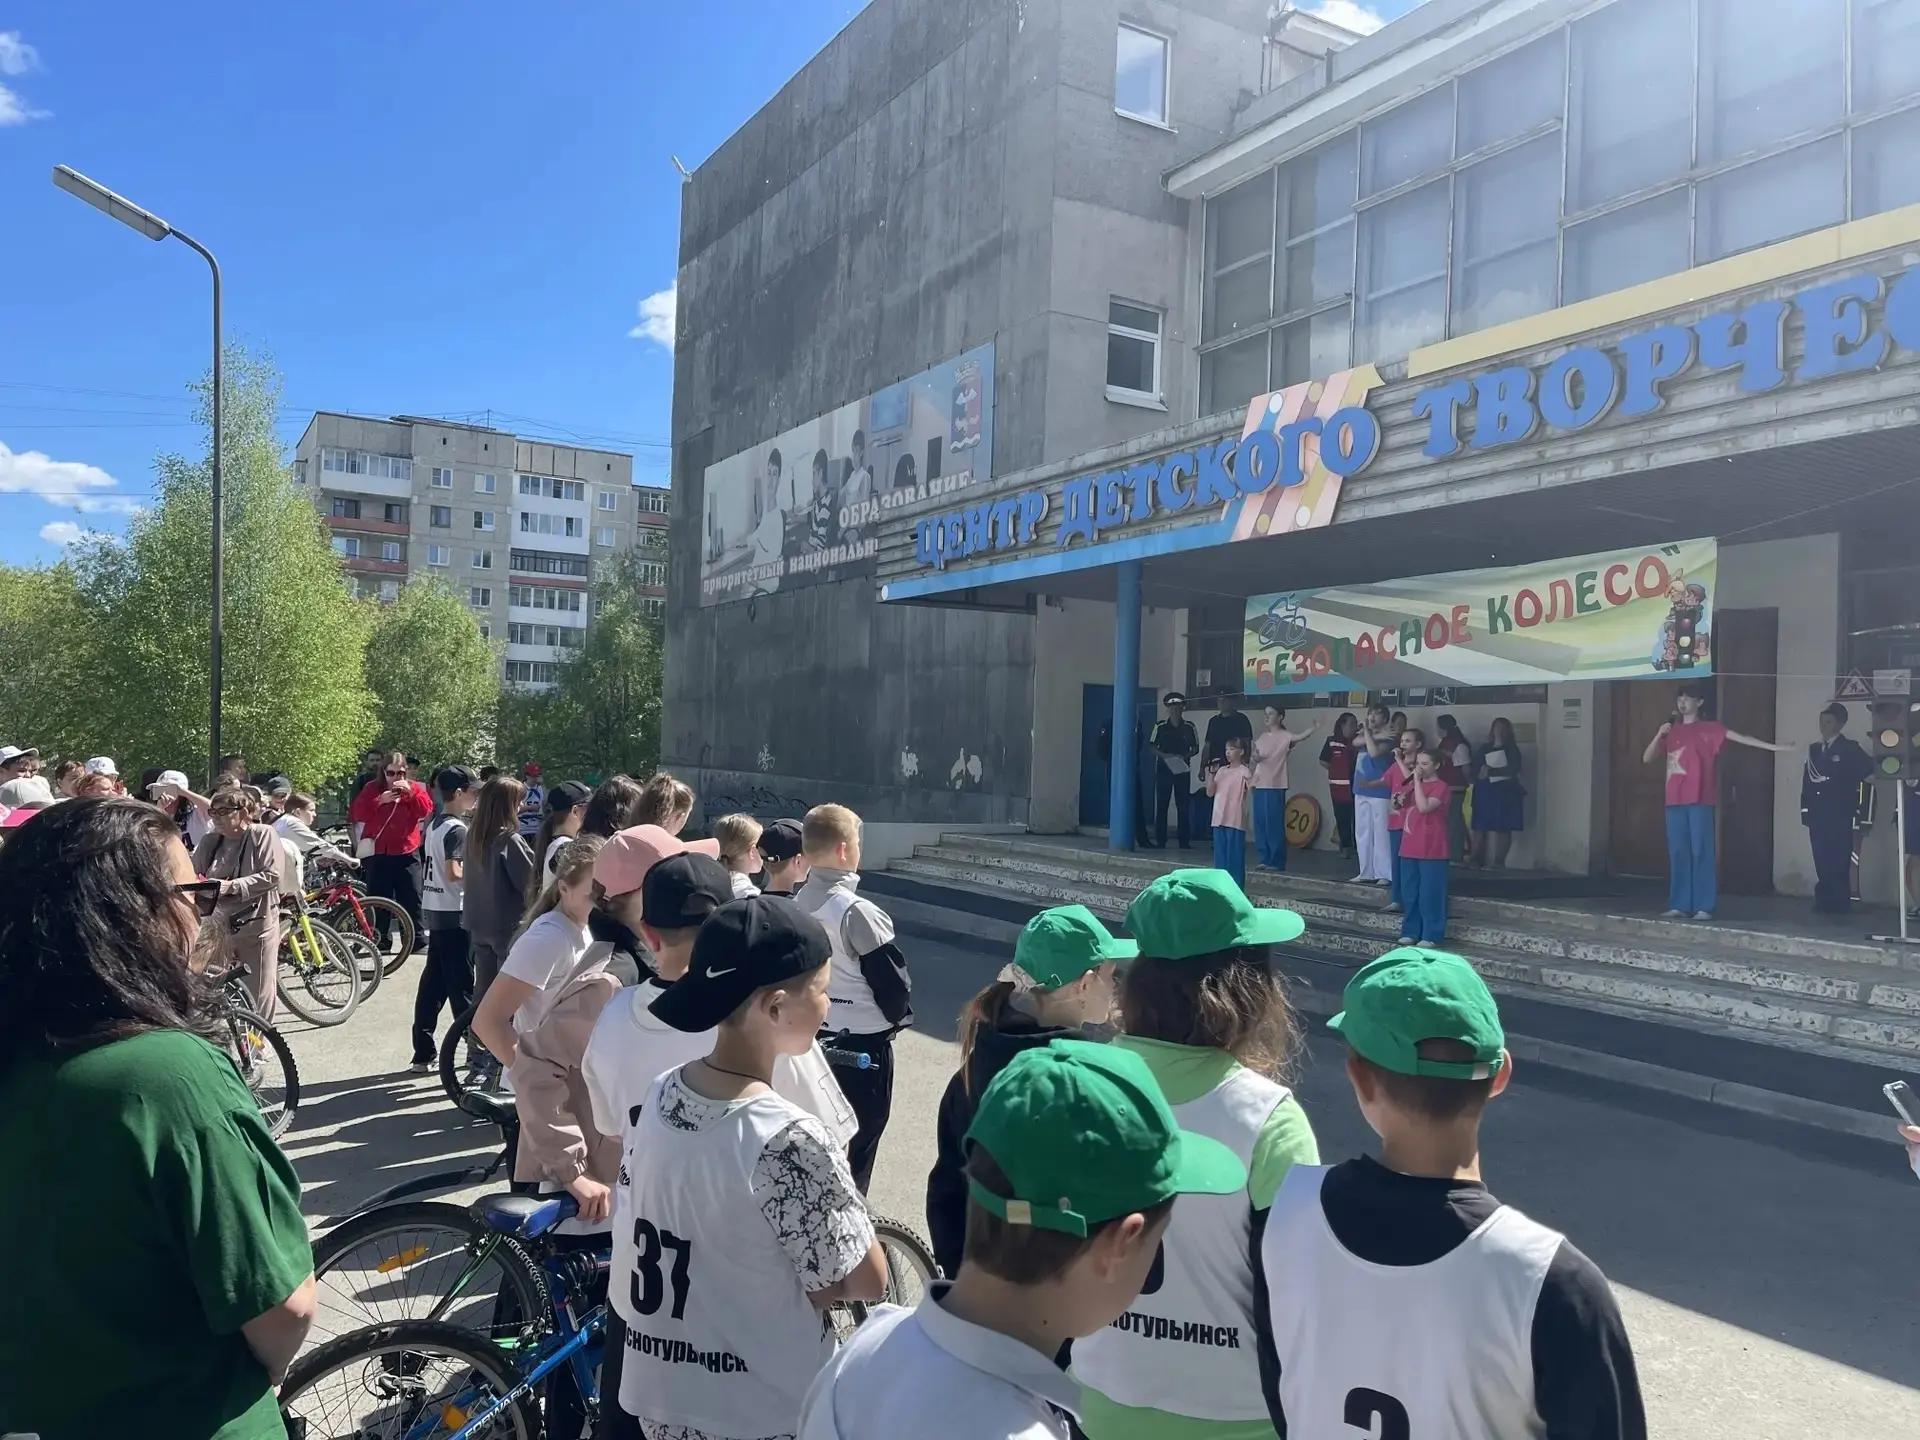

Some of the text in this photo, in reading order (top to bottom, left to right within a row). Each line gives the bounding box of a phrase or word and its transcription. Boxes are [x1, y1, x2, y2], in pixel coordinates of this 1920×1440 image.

[915, 490, 1050, 571] ЦЕНТР
[1055, 406, 1381, 548] ДЕТСКОГО
[703, 555, 784, 595] приоритетный
[1286, 808, 1310, 834] 20
[630, 1217, 691, 1321] 37
[465, 1383, 529, 1440] FORWARD
